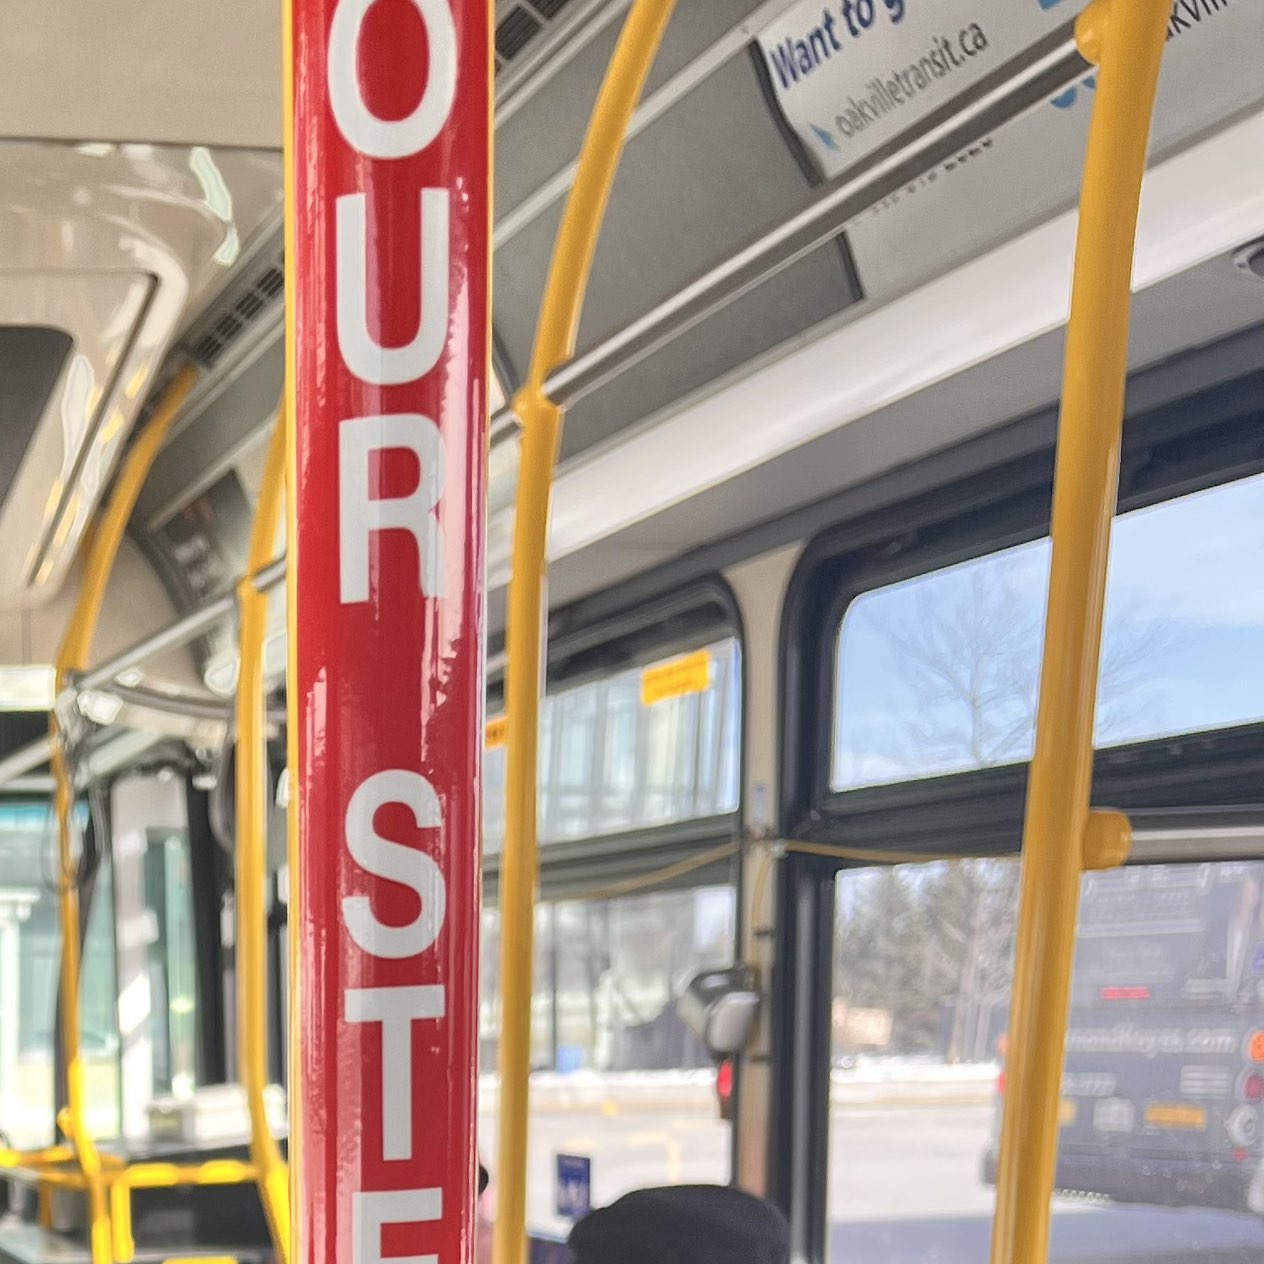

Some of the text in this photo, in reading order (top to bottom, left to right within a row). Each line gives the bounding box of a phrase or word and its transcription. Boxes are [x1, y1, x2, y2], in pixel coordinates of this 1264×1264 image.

[770, 9, 841, 88] Want
[842, 0, 874, 36] to
[835, 23, 989, 137] oakvilletransit.ca
